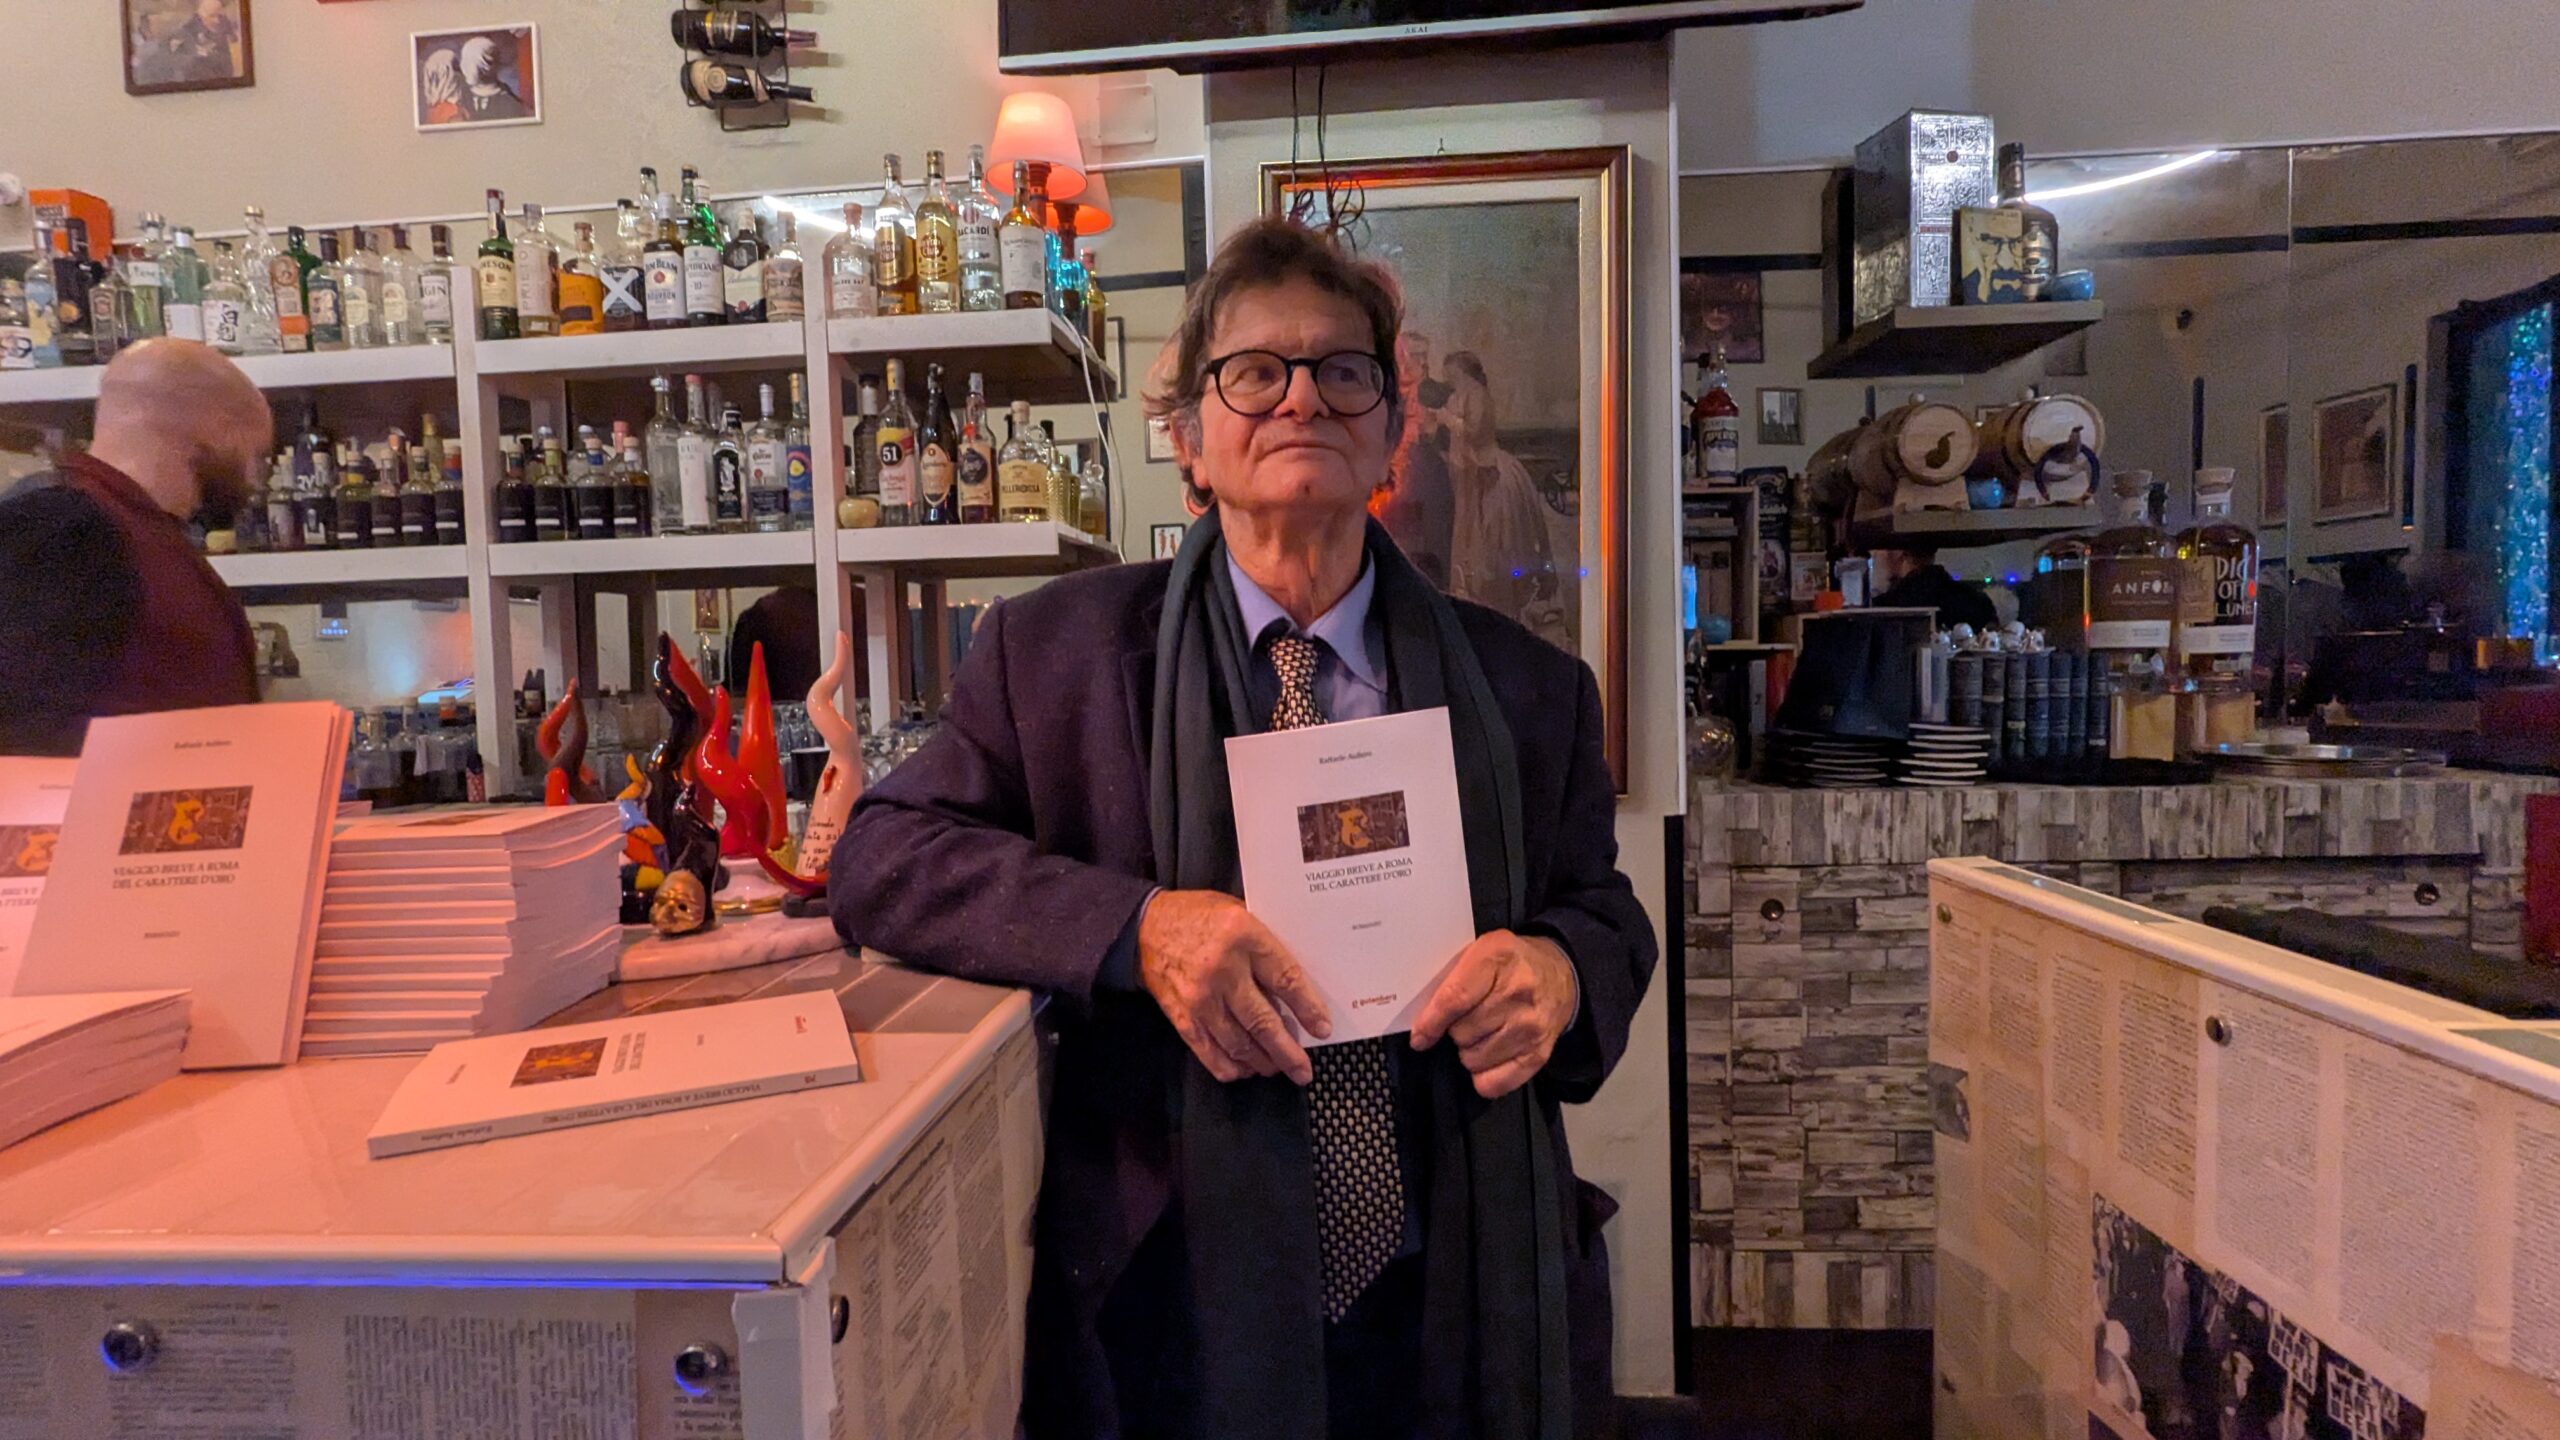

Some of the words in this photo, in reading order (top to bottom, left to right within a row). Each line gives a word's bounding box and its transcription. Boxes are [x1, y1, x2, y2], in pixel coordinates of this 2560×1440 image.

[1404, 25, 1428, 34] AKAI
[656, 257, 678, 274] BEAM
[424, 285, 447, 297] GIN
[882, 445, 898, 462] 51
[207, 861, 239, 872] ROMA
[1305, 868, 1346, 882] VIAGGIO
[1346, 863, 1375, 876] BREVE
[1385, 857, 1413, 869] ROMA
[135, 875, 200, 888] CARATTERE
[1309, 883, 1328, 893] DEL
[1328, 873, 1382, 891] CARATTERE
[1383, 868, 1412, 881] D'ORO
[654, 1097, 681, 1107] ROMA
